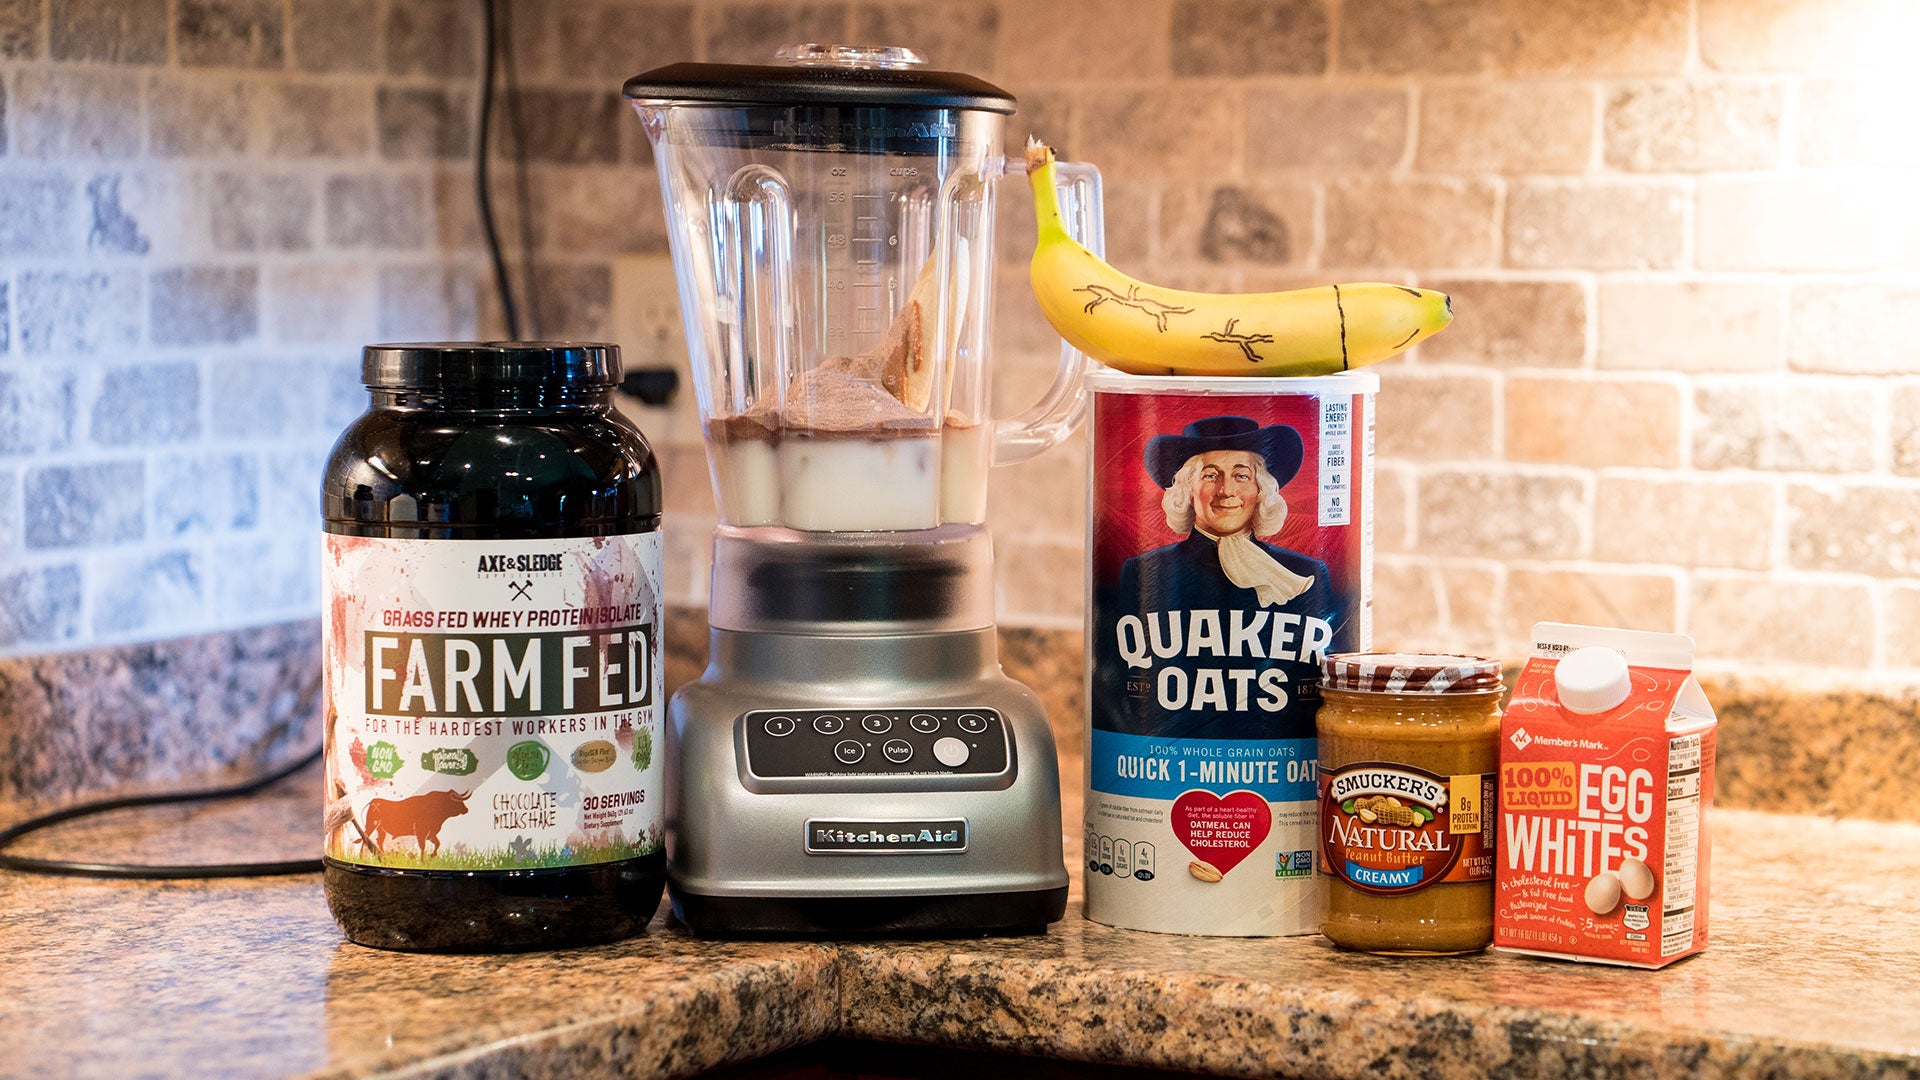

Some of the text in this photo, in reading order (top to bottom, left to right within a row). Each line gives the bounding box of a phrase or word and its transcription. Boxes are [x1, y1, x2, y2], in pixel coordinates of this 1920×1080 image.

[831, 168, 846, 176] oz
[890, 168, 918, 178] cups
[829, 192, 845, 202] 56
[889, 192, 897, 202] 7
[827, 234, 846, 245] 48
[888, 235, 897, 246] 6
[1325, 403, 1347, 413] LASTING
[1325, 413, 1347, 422] ENERGY
[1327, 457, 1345, 466] FIBER
[1332, 474, 1341, 484] NO
[1331, 497, 1340, 506] NO
[383, 603, 641, 628] GRASS FED WHEY PROTEIN ISOLATE
[1116, 609, 1333, 669] QUAKER
[371, 630, 648, 712] FARM FED
[1157, 666, 1288, 712] OATS
[366, 708, 653, 736] FOR THE HARDEST WORKERS IN THE GYM
[921, 719, 928, 727] 4
[1534, 735, 1604, 750] Member's Mark
[371, 747, 394, 760] NON
[844, 747, 856, 755] Ice
[888, 746, 908, 755] Pulse
[1149, 745, 1296, 757] 100% WHOLE GRAIN OATS
[371, 760, 393, 772] GMO
[1117, 755, 1318, 784] QUICK 1-MINUTE OAT
[1504, 766, 1573, 788] 100%
[1336, 774, 1438, 801] SMUCKER'S
[1579, 763, 1653, 823] EGG
[492, 792, 557, 811] CHOCOLATE
[583, 789, 645, 811] 30 SERVINGS
[1460, 797, 1471, 811] 8g
[1506, 791, 1573, 808] LIQUID
[493, 811, 556, 830] MILKSHAKE
[593, 812, 606, 820] Weight
[1452, 812, 1479, 823] PROTEIN
[584, 819, 623, 830] Dietary Supplement
[1190, 821, 1251, 830] OATMEAL CAN
[816, 829, 958, 843] KitchenAid
[1190, 830, 1250, 839] HELP REDUCE
[1329, 815, 1450, 851] NATURAL
[1190, 839, 1251, 848] CHOLESTEROL
[1345, 849, 1425, 865] Peanut Butter
[1355, 869, 1411, 884] CREAMY
[1501, 874, 1570, 891] A cholesterol free
[1521, 888, 1574, 903] & fat free food
[1510, 899, 1547, 912] Pasteurized
[1513, 911, 1528, 921] Good
[1548, 914, 1555, 923] of
[1556, 916, 1576, 929] Protein
[1586, 917, 1594, 929] 5
[1500, 927, 1509, 937] NET
[1509, 927, 1517, 938] WT
[1518, 929, 1524, 939] 16
[1525, 930, 1532, 940] OZ
[1548, 933, 1558, 943] 454
